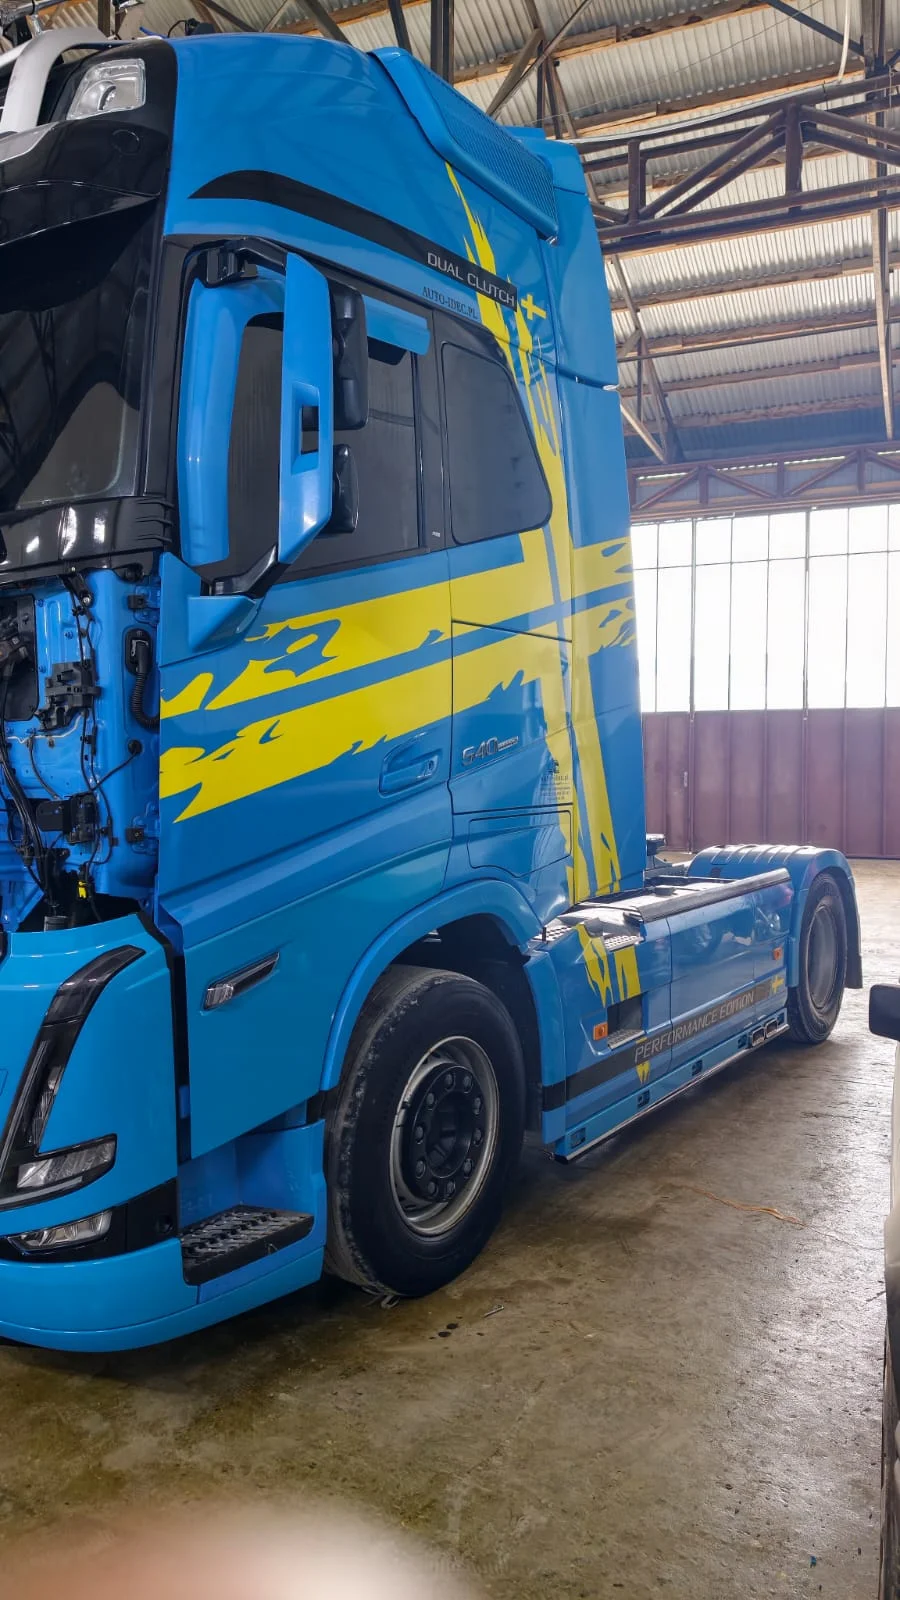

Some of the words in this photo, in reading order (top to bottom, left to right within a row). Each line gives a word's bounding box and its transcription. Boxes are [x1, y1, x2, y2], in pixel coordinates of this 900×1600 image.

[427, 252, 463, 280] DUAL
[467, 272, 515, 307] CLUTCH
[634, 1009, 718, 1063] PERFORMANCE
[720, 990, 755, 1018] EDITION
